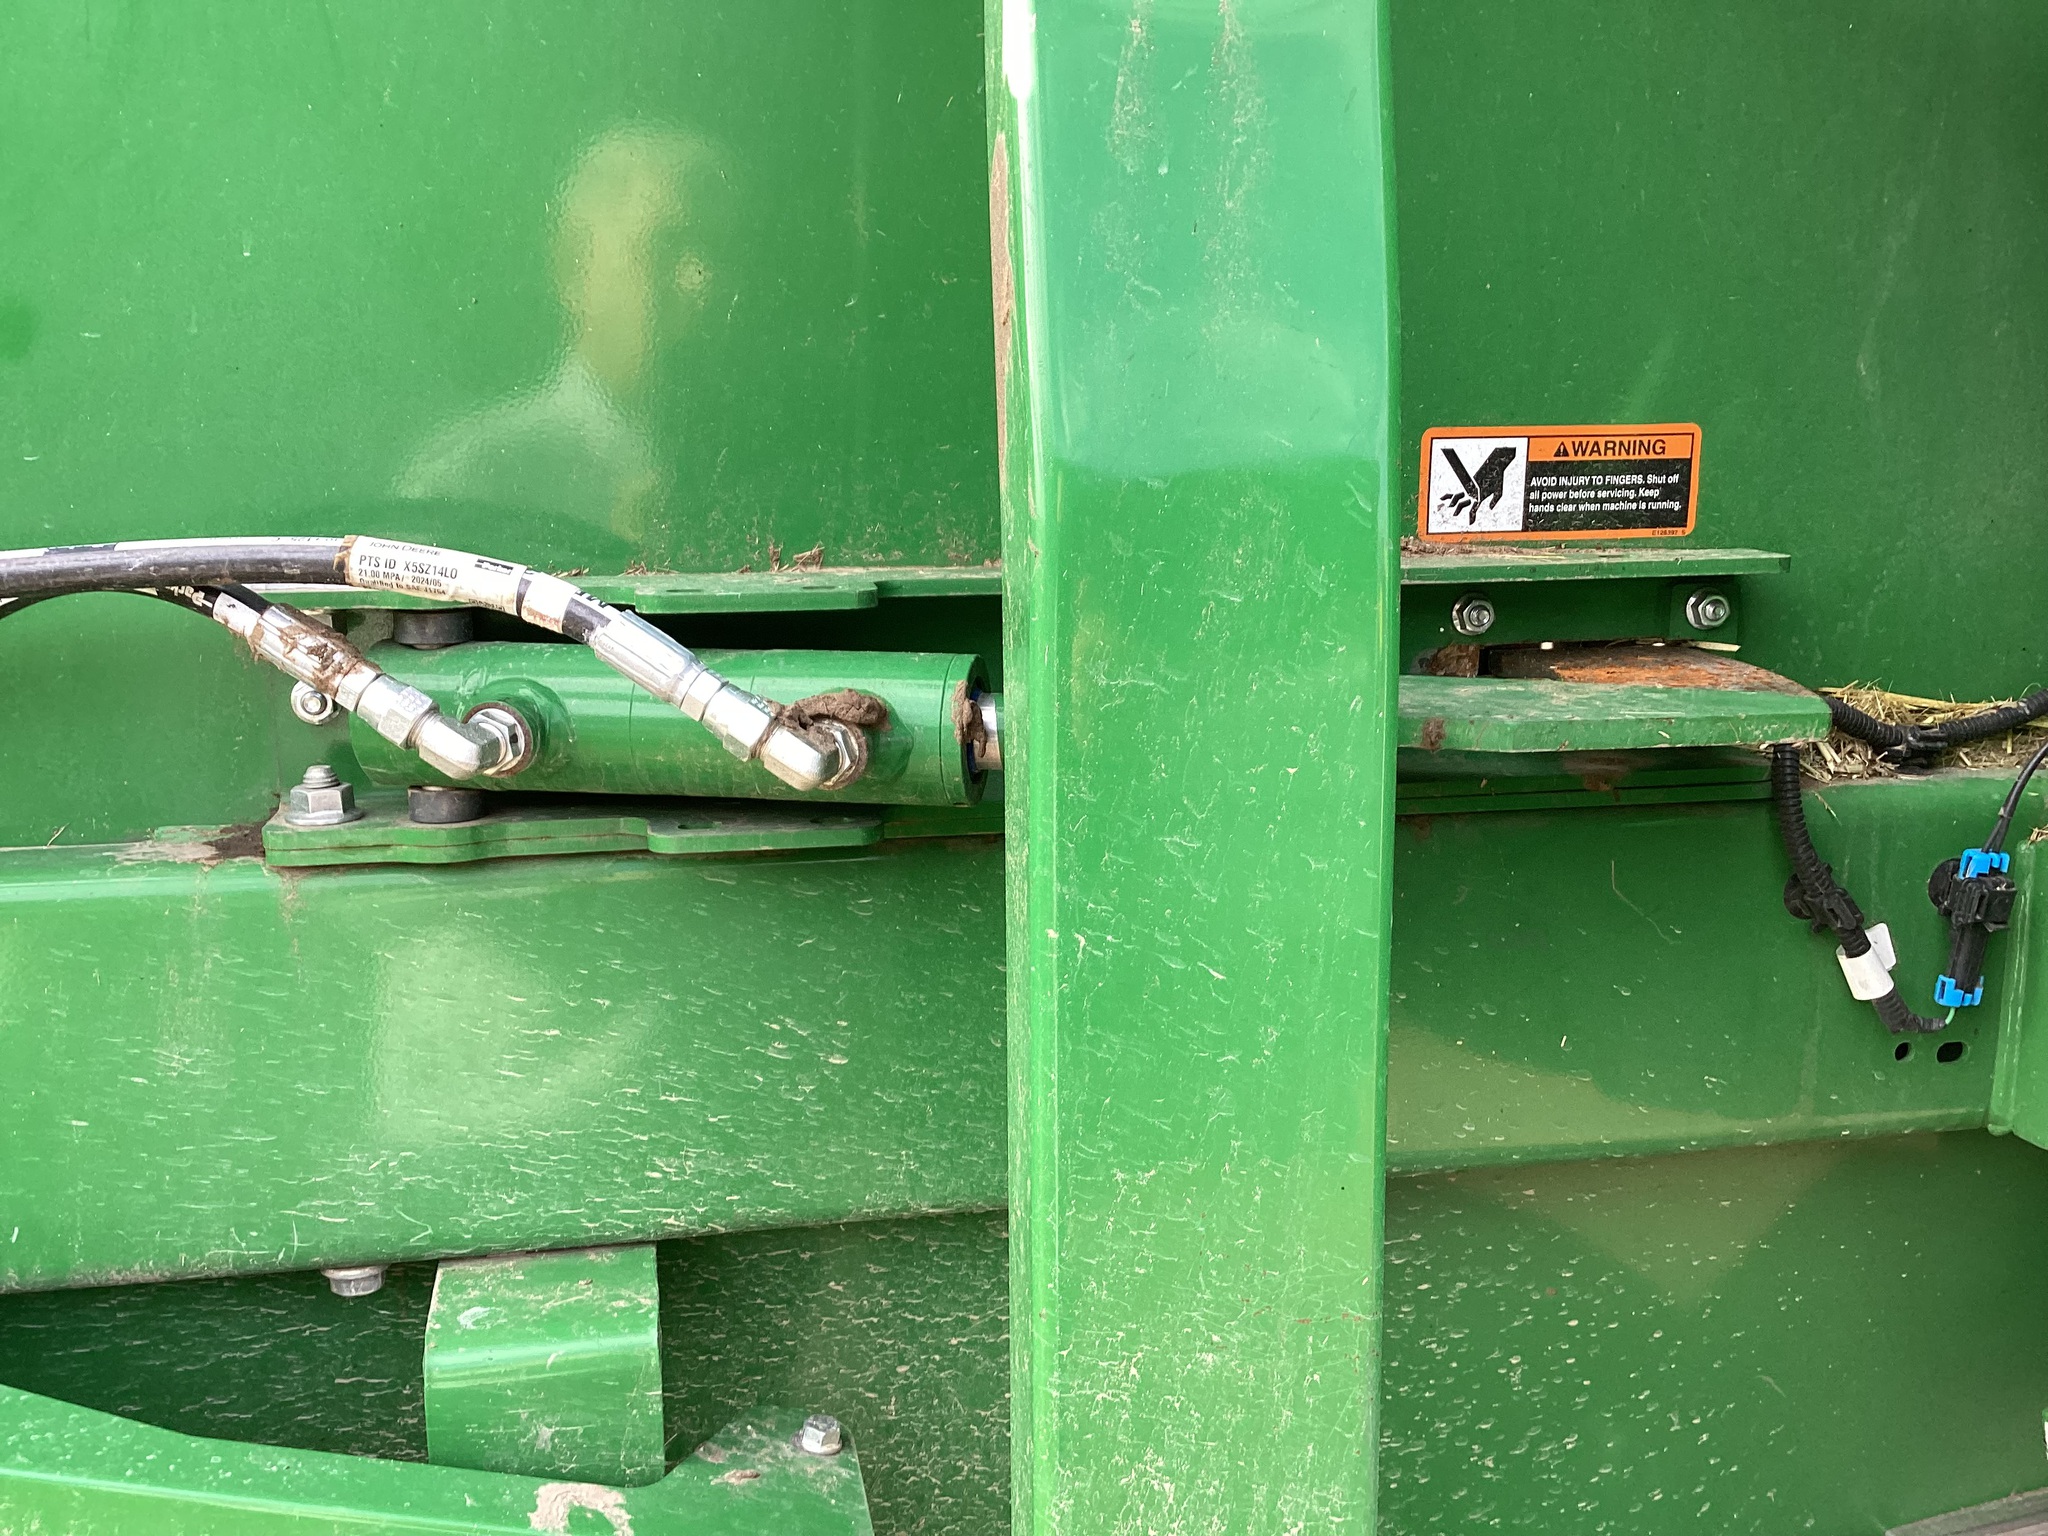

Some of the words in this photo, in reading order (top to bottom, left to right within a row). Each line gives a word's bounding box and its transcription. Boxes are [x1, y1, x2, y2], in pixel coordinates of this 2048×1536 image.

[1571, 438, 1667, 457] WARNING
[1530, 476, 1557, 487] AVOID
[1559, 475, 1590, 487] INJURY
[1591, 475, 1603, 485] TO
[1604, 474, 1646, 485] FINGERS.
[1646, 474, 1666, 484] Shut
[1667, 473, 1679, 484] off
[1529, 490, 1540, 500] all
[1541, 490, 1568, 502] power
[1568, 488, 1596, 499] before
[1596, 487, 1637, 499] servicing.
[1638, 487, 1660, 499] Keep
[1528, 502, 1555, 513] hands
[1555, 502, 1577, 512] clear
[1578, 501, 1600, 512] when
[1602, 500, 1637, 511] machine
[1638, 500, 1647, 510] is
[1647, 499, 1682, 511] running.
[369, 541, 400, 551] JOHN
[401, 545, 442, 556] DEERE
[358, 554, 381, 568] PTS
[384, 558, 397, 570] ID
[358, 568, 381, 579] 21.00
[411, 575, 442, 588] 2024/05
